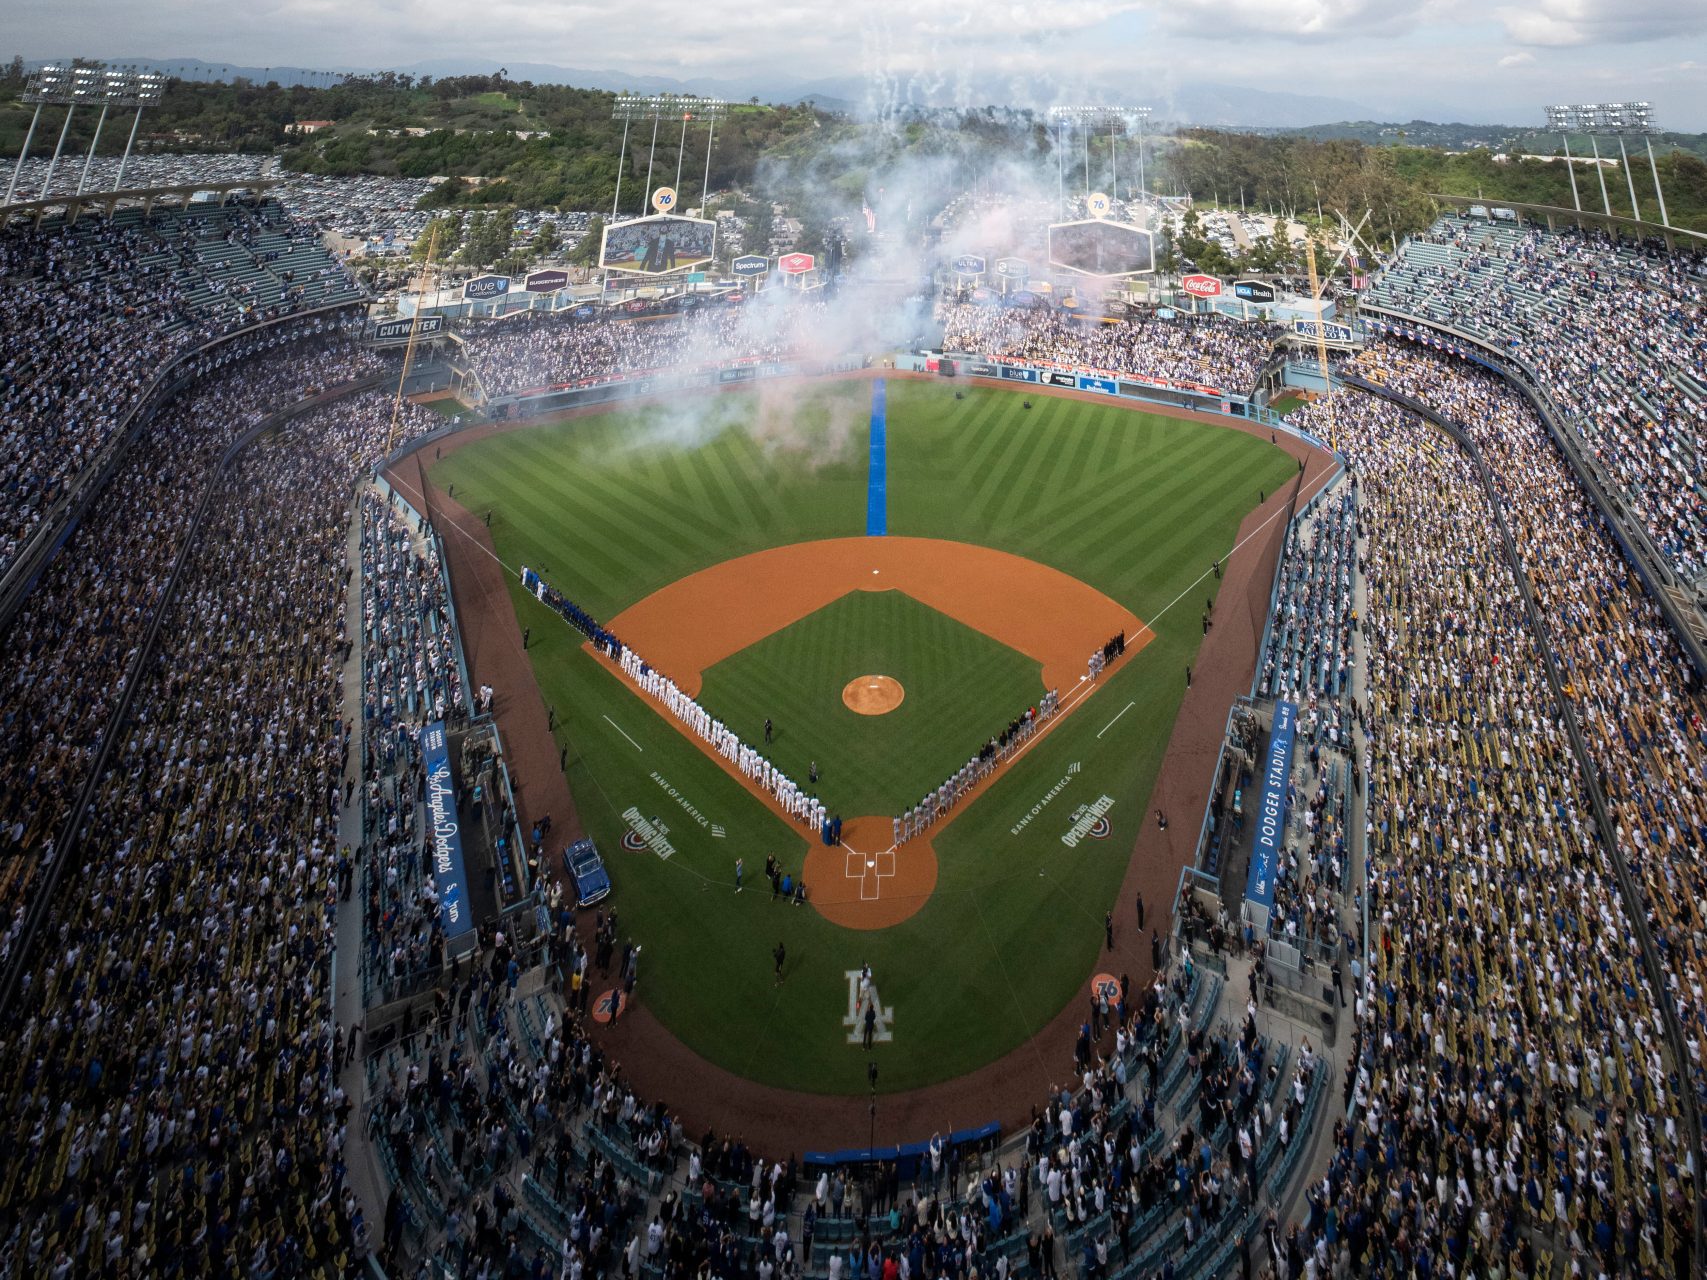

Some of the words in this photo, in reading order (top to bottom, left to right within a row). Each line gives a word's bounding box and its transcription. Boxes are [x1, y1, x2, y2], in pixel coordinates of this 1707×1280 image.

[659, 194, 672, 205] 76
[1093, 200, 1105, 210] 76
[735, 261, 765, 270] Spectrum
[958, 260, 978, 268] ULTRA
[469, 281, 495, 294] blue
[471, 290, 497, 298] california
[1186, 279, 1217, 293] Coca-Cola
[1236, 287, 1251, 296] UCLA
[1252, 289, 1272, 299] Health
[379, 319, 437, 337] CUTWATER
[1299, 327, 1337, 339] JALICO
[427, 766, 450, 785] Los
[427, 784, 453, 826] Angeles
[649, 771, 671, 791] BANK
[667, 788, 680, 798] OF
[676, 796, 709, 828] AMERICA
[1010, 812, 1034, 835] BANK
[1031, 803, 1043, 815] OF
[1041, 775, 1073, 806] AMERICA
[1061, 812, 1098, 848] OPENING
[1087, 794, 1116, 819] WEEK
[1260, 791, 1280, 847] DODGER
[621, 806, 658, 841] OPENING
[647, 832, 677, 861] WEEK
[433, 822, 458, 874] Dodgers
[1097, 980, 1119, 998] 76
[843, 969, 894, 1045] LA
